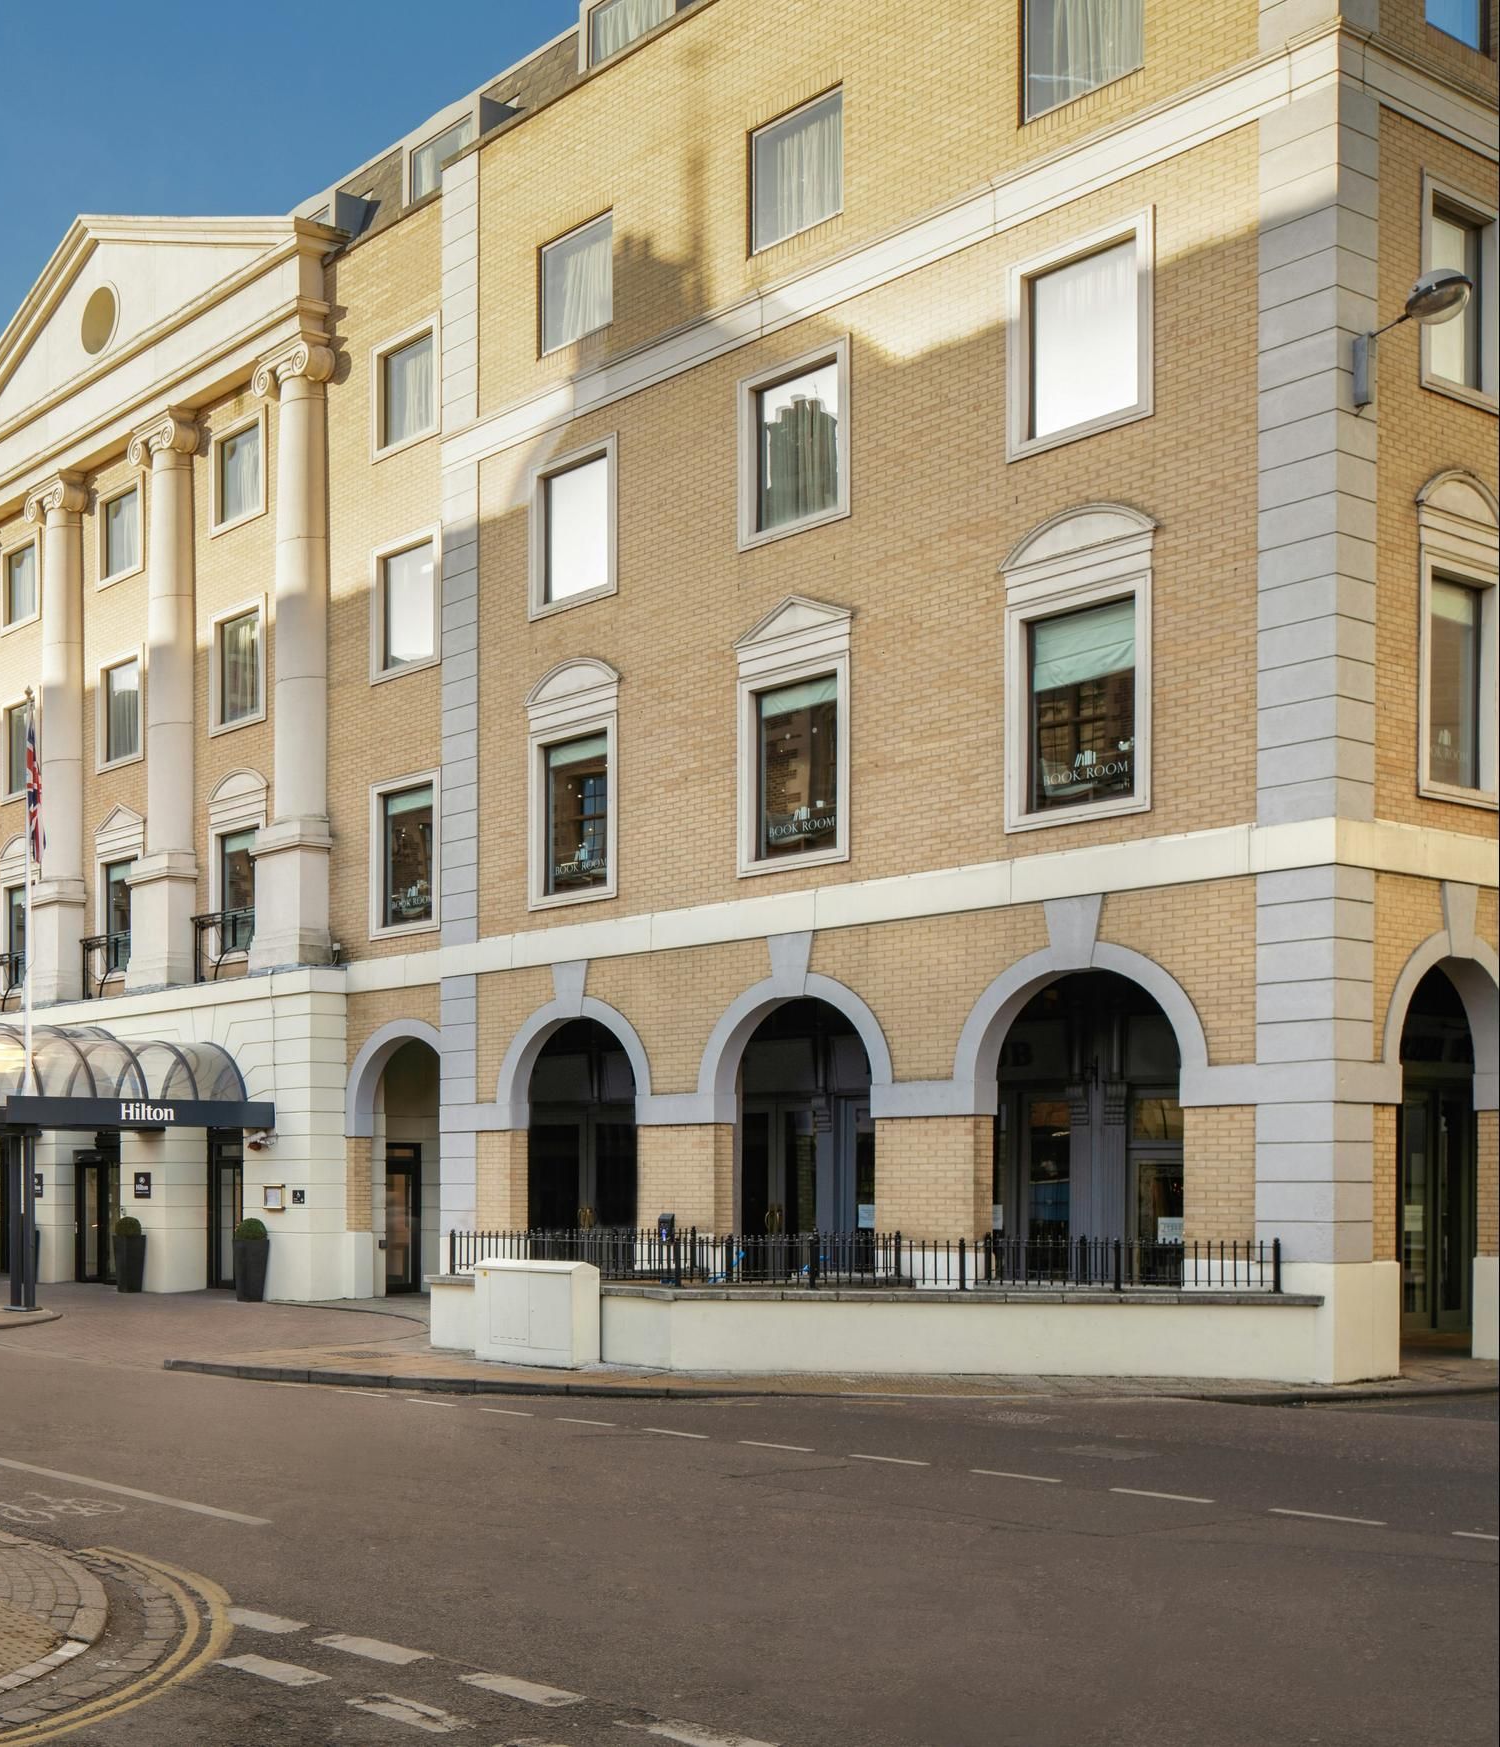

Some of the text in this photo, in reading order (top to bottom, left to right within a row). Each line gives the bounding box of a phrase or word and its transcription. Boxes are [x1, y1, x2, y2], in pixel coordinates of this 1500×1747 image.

[1044, 769, 1081, 787] BOOK
[1086, 761, 1128, 779] ROOM
[769, 815, 835, 839] BOOK ROOM
[555, 863, 579, 875] BOOK
[120, 1102, 175, 1121] Hilton
